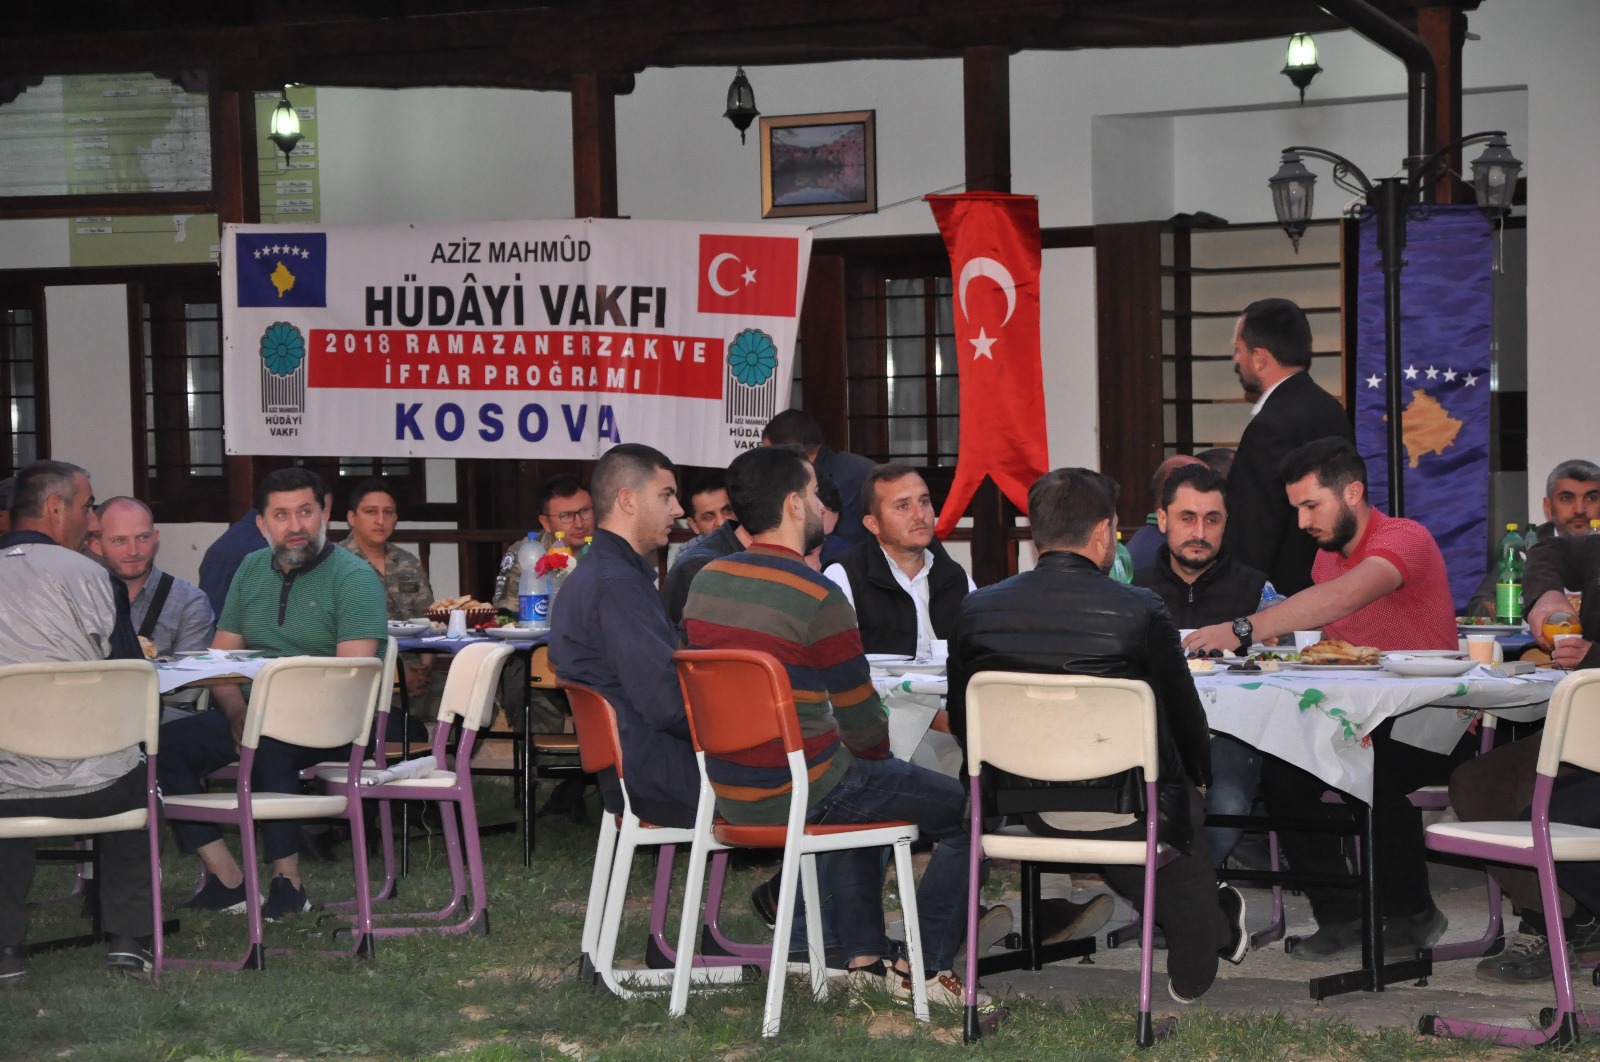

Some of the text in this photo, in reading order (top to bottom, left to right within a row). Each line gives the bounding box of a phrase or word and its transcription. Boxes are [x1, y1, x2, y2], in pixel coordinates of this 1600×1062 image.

[430, 235, 591, 263] AZİZ MAHMÛD
[365, 272, 667, 329] HÜDÂYİ VAKFI
[324, 333, 706, 363] 2018 RAMAZAN ERZAK VE
[384, 358, 642, 389] İFTAR PROĞRAMI
[265, 415, 302, 425] HÜDÂYİ
[269, 428, 298, 436] VAKFI
[395, 402, 622, 443] KOSOVA
